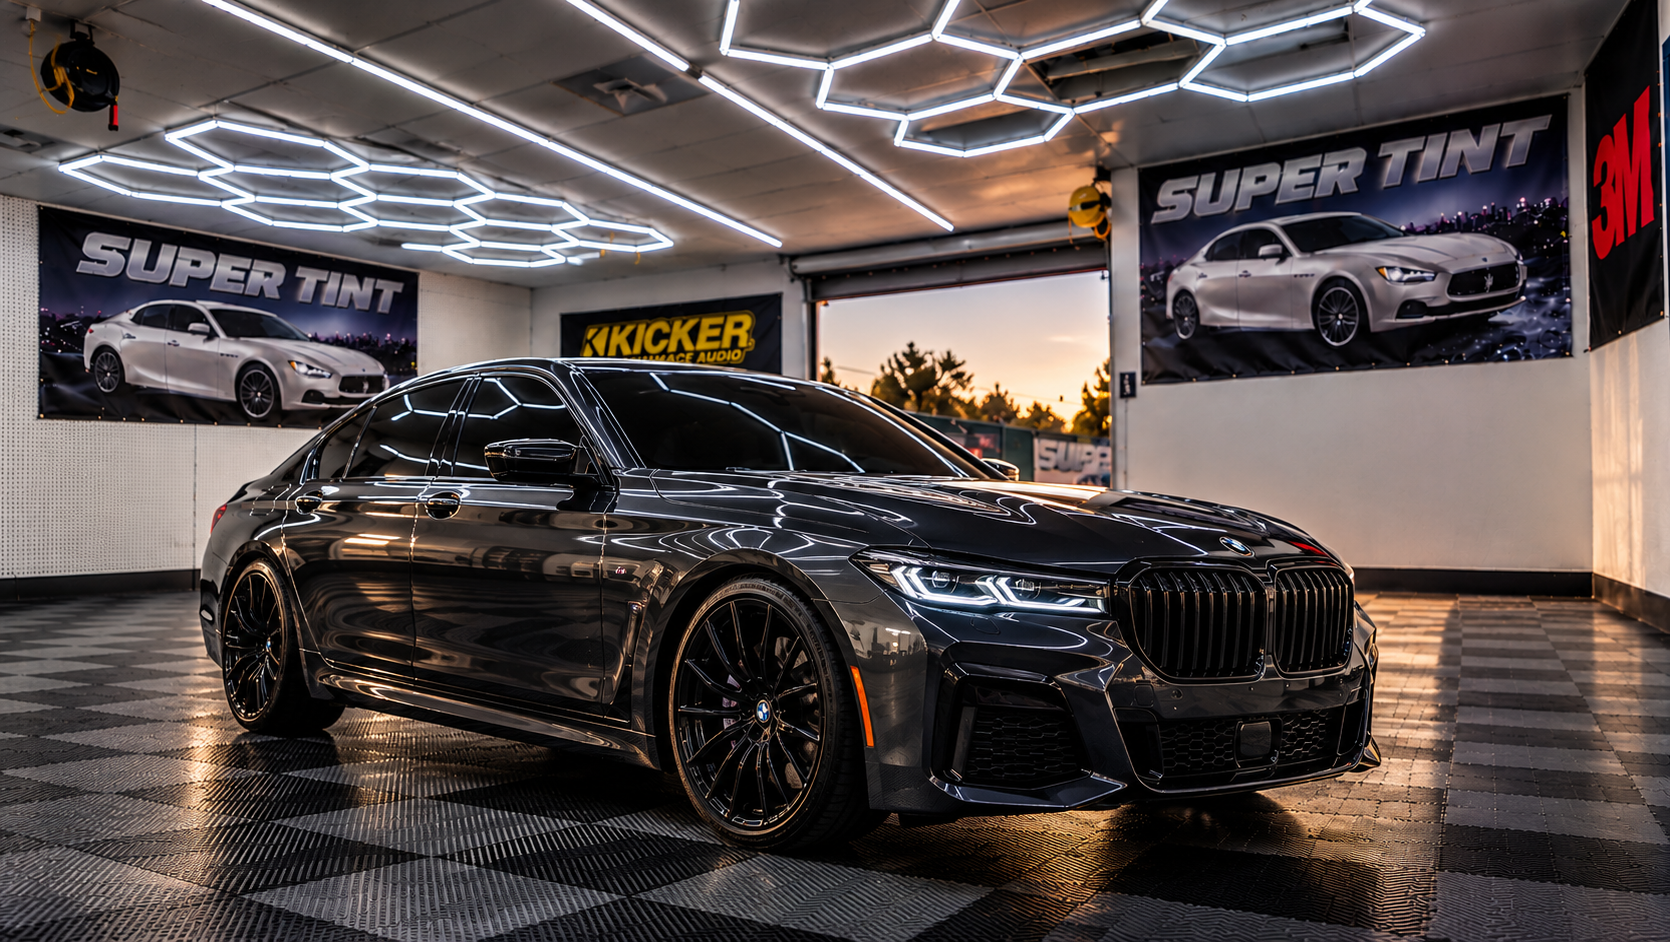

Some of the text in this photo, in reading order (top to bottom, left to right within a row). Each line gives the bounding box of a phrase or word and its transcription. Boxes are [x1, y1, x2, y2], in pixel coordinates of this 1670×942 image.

[1151, 114, 1551, 224] SUPER TINT
[1593, 85, 1655, 260] 3M
[77, 232, 403, 313] SUPER TINT
[608, 313, 752, 356] KICKER
[696, 349, 742, 364] AUDIO
